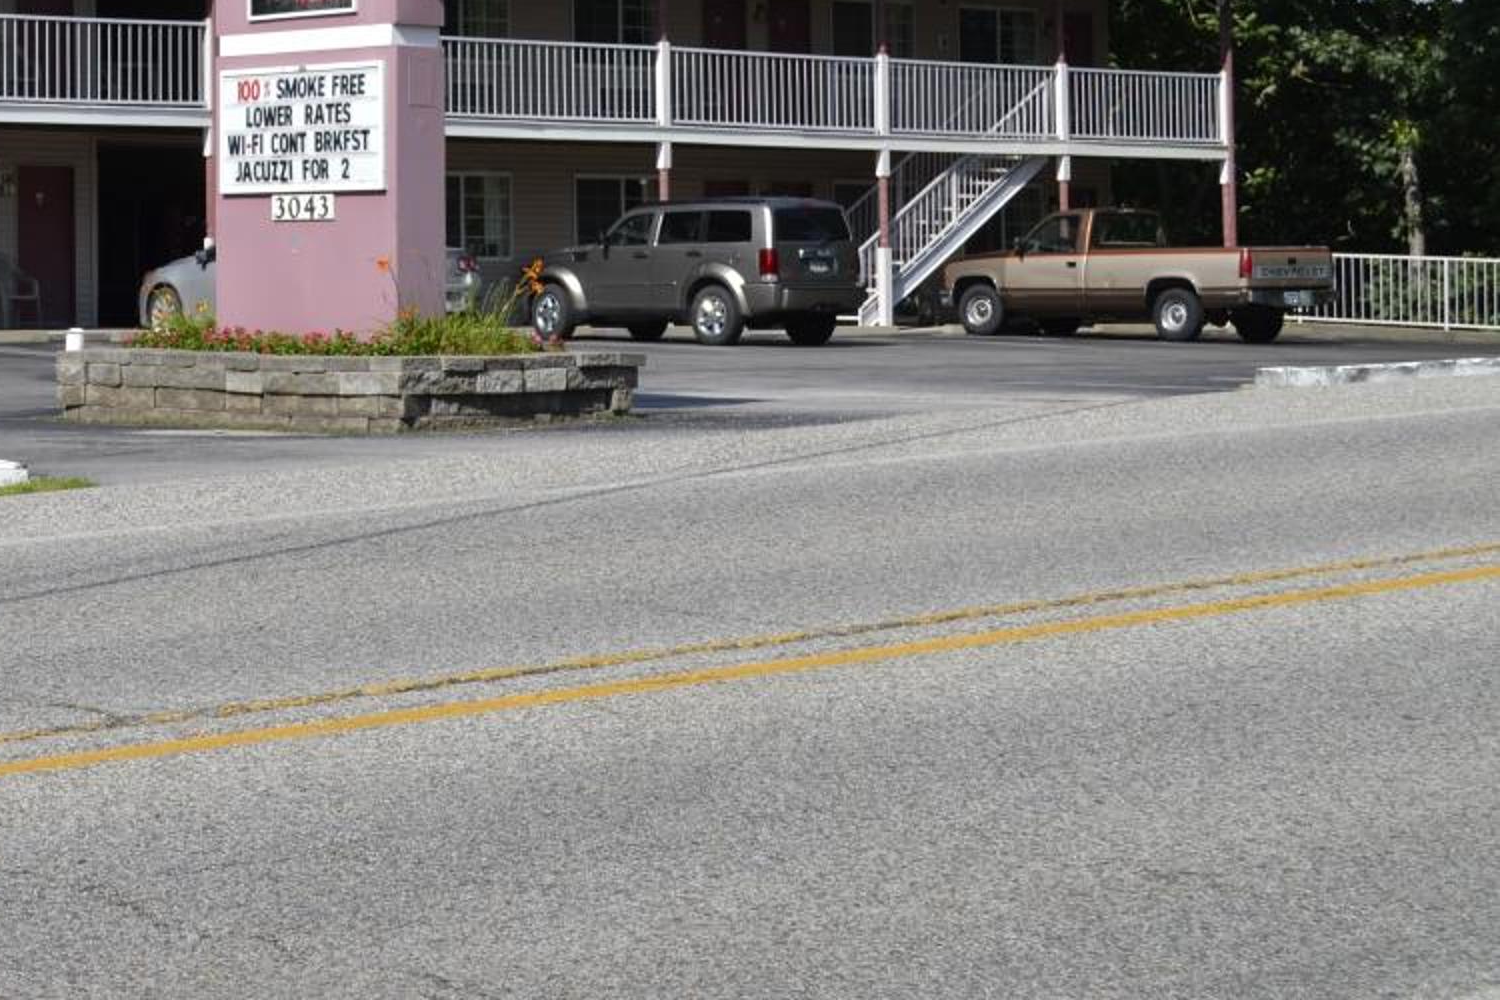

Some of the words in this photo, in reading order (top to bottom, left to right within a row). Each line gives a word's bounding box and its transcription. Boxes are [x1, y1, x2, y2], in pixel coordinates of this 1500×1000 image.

[276, 75, 326, 99] SMOKE
[332, 73, 365, 96] FREE
[245, 104, 293, 128] LOWER
[304, 102, 351, 125] RATES
[227, 133, 264, 155] WI-FI
[271, 131, 306, 154] CONT
[314, 129, 370, 152] BRKFST
[235, 159, 293, 183] JACUZZI
[302, 158, 329, 180] FOR
[341, 157, 350, 179] 2
[275, 196, 329, 219] 3043
